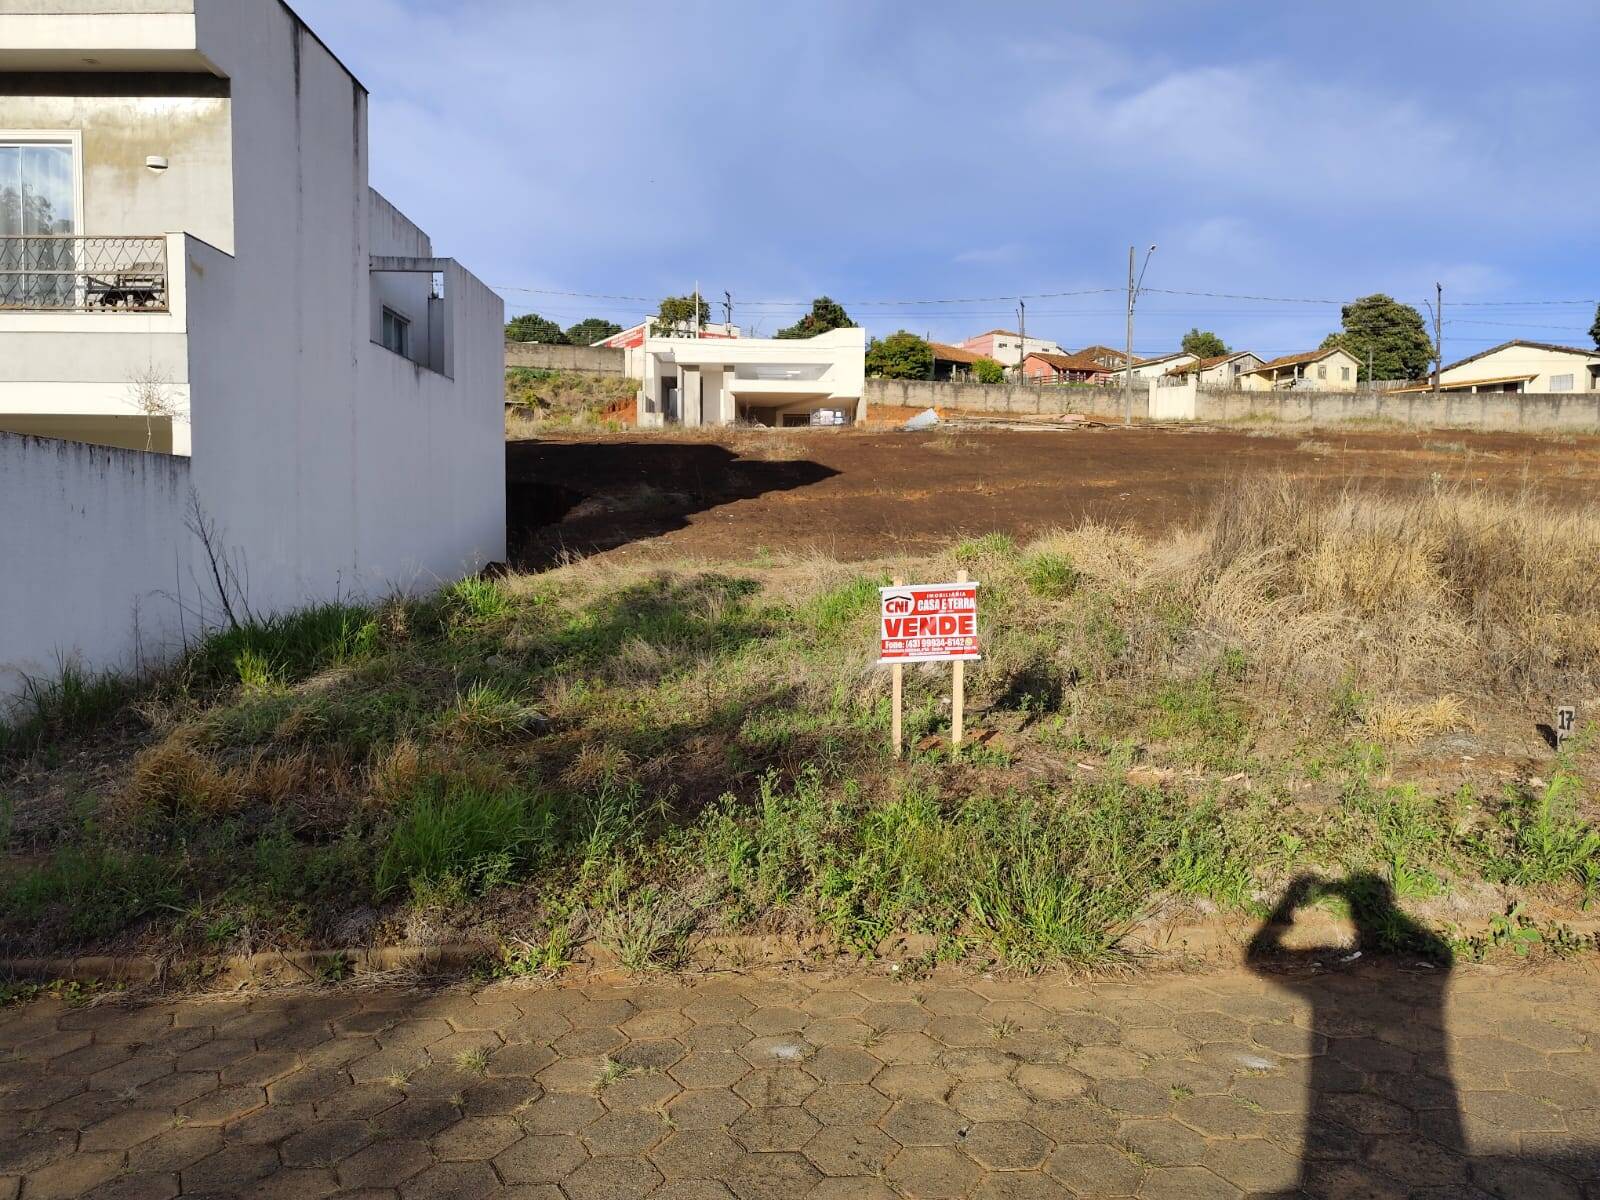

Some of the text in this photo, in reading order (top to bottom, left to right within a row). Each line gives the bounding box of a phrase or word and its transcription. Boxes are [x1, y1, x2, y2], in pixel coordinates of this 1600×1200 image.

[885, 601, 909, 613] CNI
[917, 597, 975, 611] CASA E TERRA
[884, 615, 973, 638] VENDE
[885, 640, 905, 649] Fone:
[1558, 709, 1575, 730] 17
